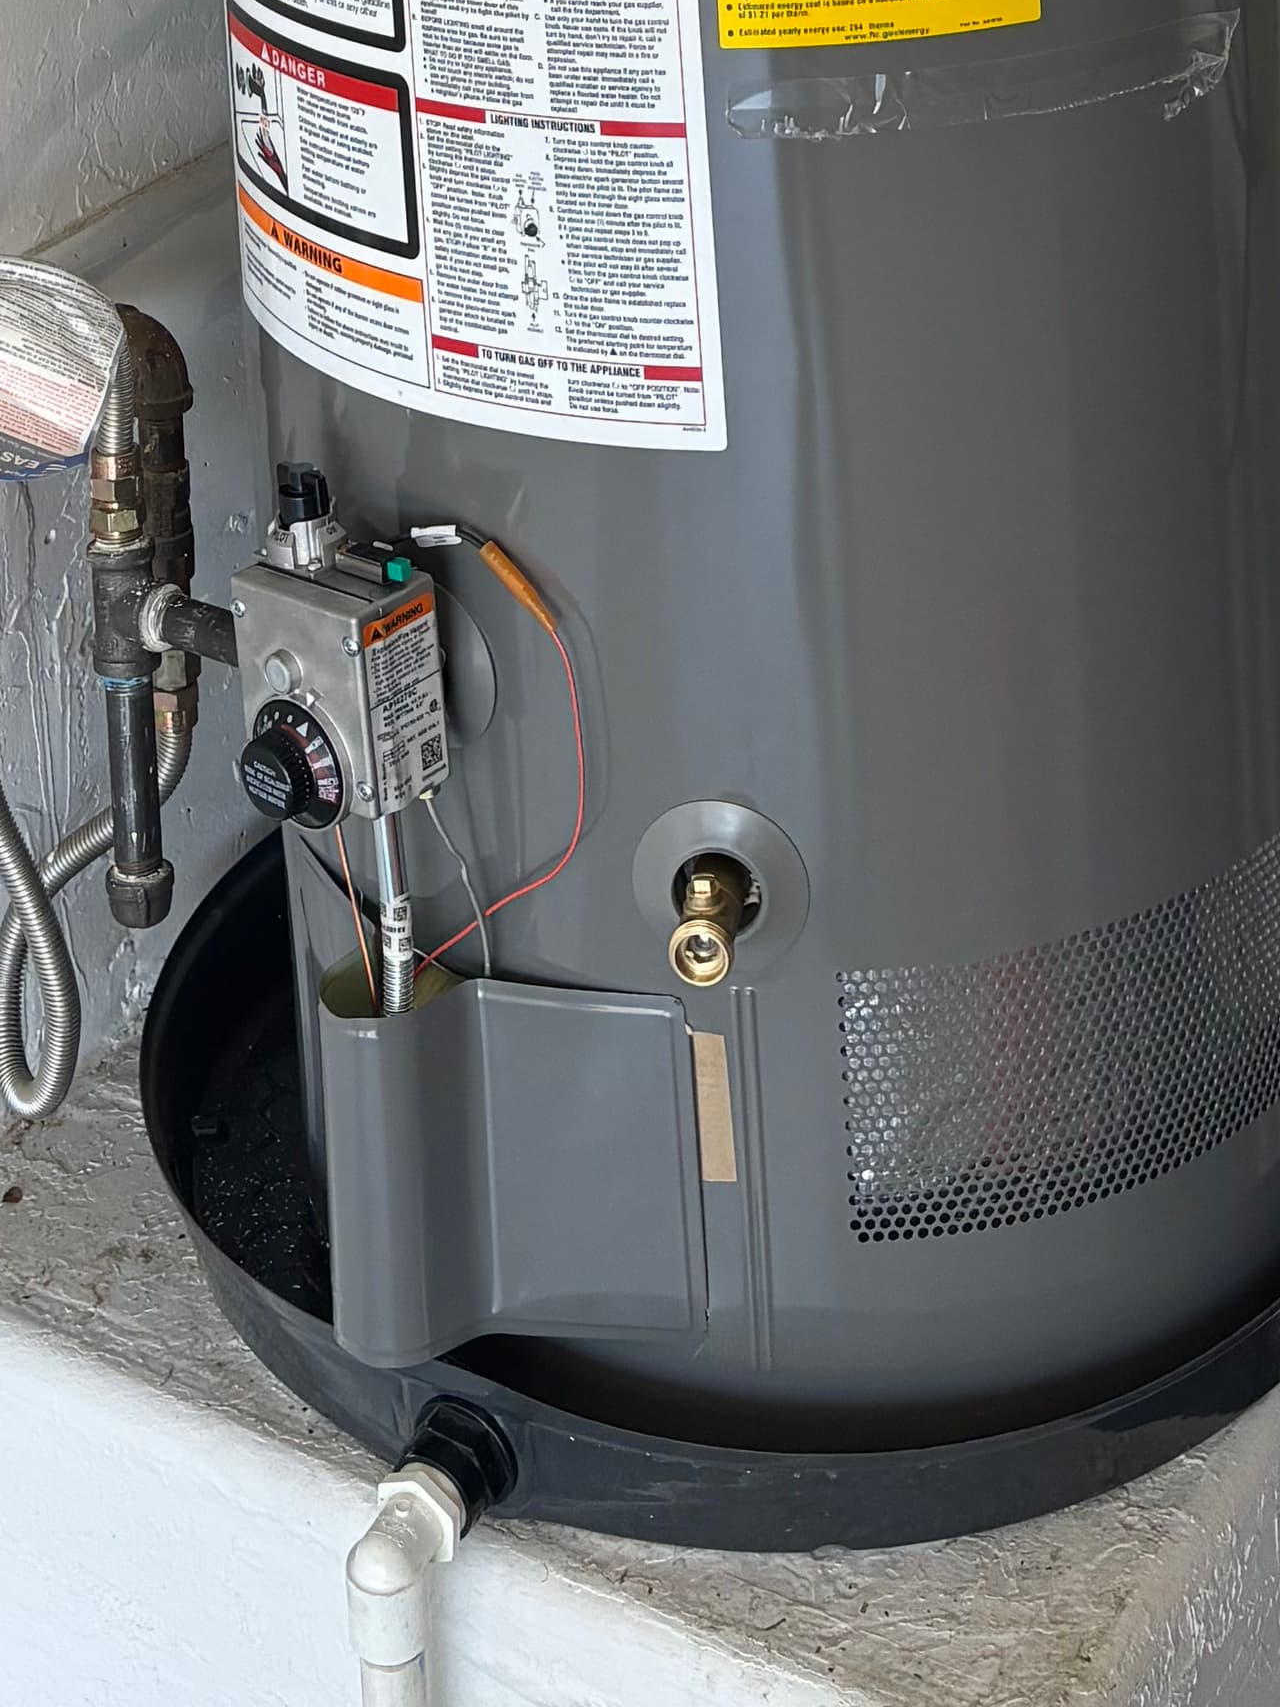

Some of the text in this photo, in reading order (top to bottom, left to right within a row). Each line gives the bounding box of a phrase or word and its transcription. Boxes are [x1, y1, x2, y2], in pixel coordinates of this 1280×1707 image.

[272, 49, 325, 88] DANGER
[490, 114, 596, 133] LIGHTING INSTRUCTIONS
[283, 231, 342, 273] WARNING
[482, 349, 641, 378] TO TURN GAS OFF TO THE APPLIANCE
